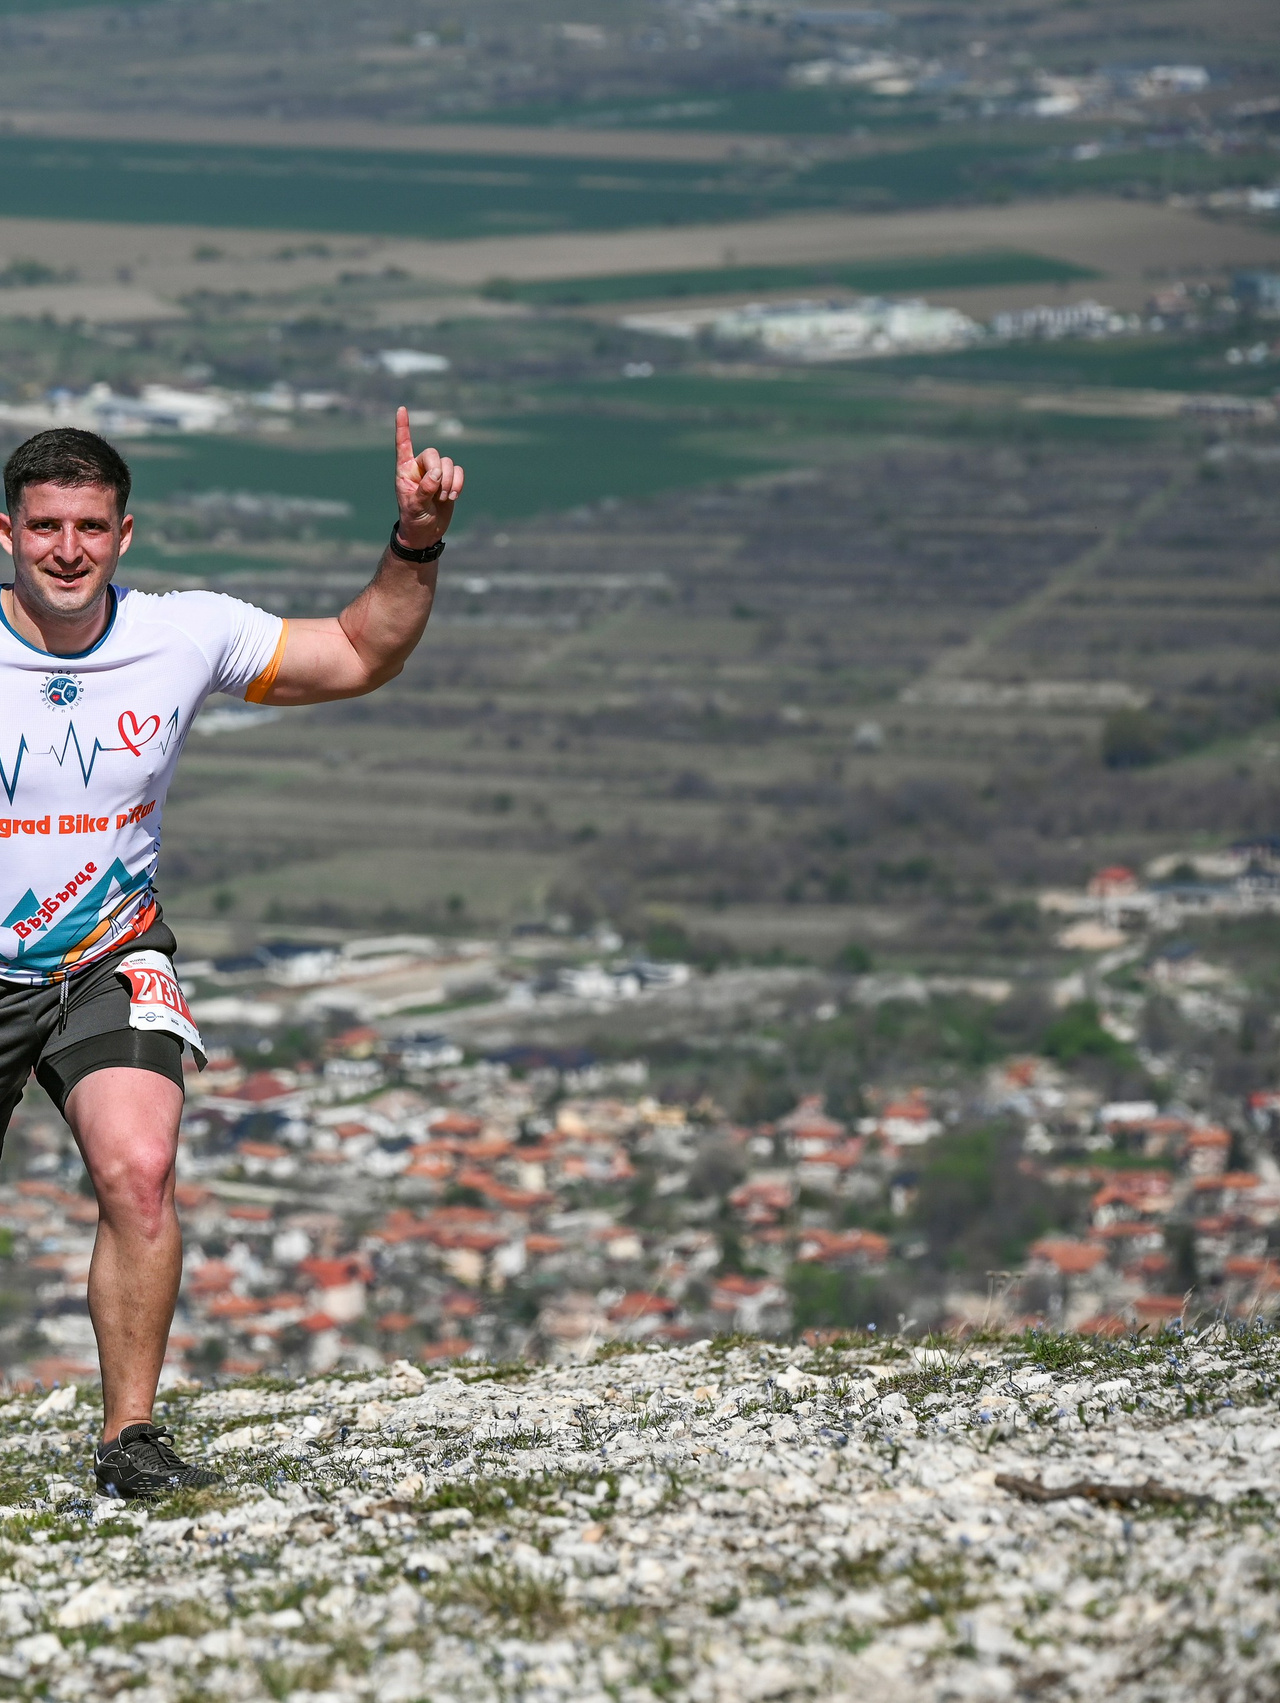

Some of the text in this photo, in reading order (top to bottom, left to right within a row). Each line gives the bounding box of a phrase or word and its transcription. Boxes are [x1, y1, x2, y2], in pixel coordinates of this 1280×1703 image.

[40, 669, 84, 693] ZLATOGRAD
[58, 814, 109, 834] Bike
[134, 971, 183, 1013] 2137
